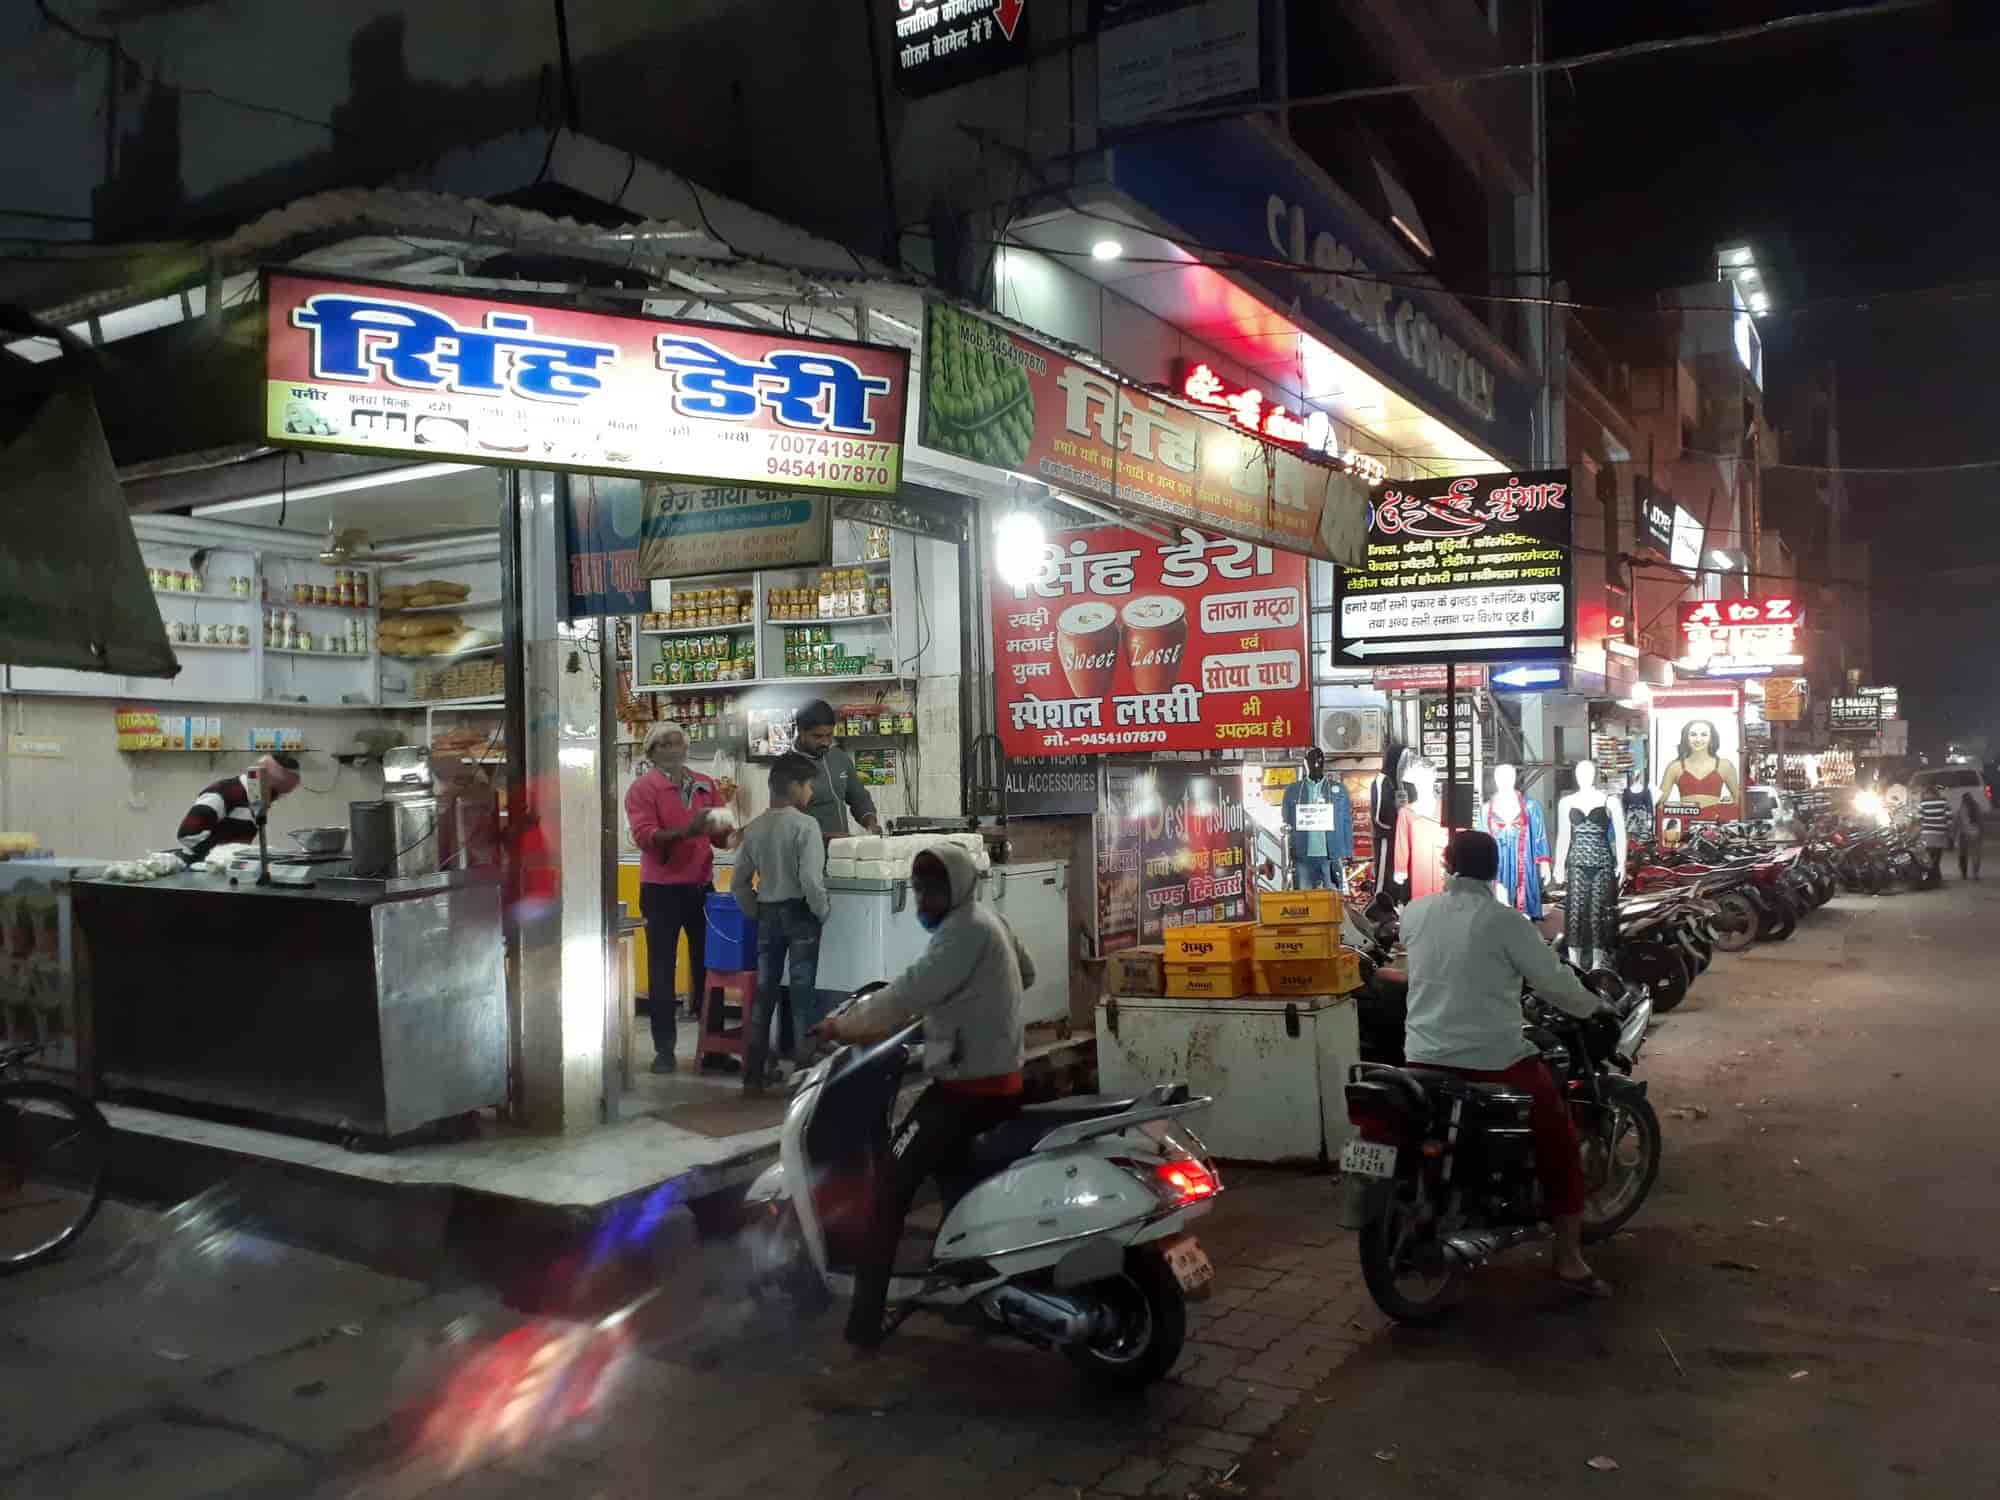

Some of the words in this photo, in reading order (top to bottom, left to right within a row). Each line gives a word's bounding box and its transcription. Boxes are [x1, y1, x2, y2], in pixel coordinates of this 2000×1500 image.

[293, 294, 617, 404] सिंह
[656, 335, 891, 434] डेरी
[289, 387, 329, 401] पनीर
[768, 433, 891, 462] 7007419477
[767, 457, 889, 485] 9454107870
[1206, 600, 1249, 622] ताजा
[1688, 602, 1722, 622] A
[1728, 603, 1760, 620] to
[1765, 600, 1793, 618] Z
[1239, 632, 1260, 649] एवं
[1063, 649, 1117, 672] Sweet
[1204, 660, 1250, 689] सोया
[1255, 661, 1296, 687] चाप
[1008, 692, 1103, 731] स्पेशल
[1112, 683, 1203, 726] लस्सी
[1242, 695, 1262, 717] भी
[1005, 772, 1026, 793] ALL
[1027, 772, 1096, 793] ACCESSORIES
